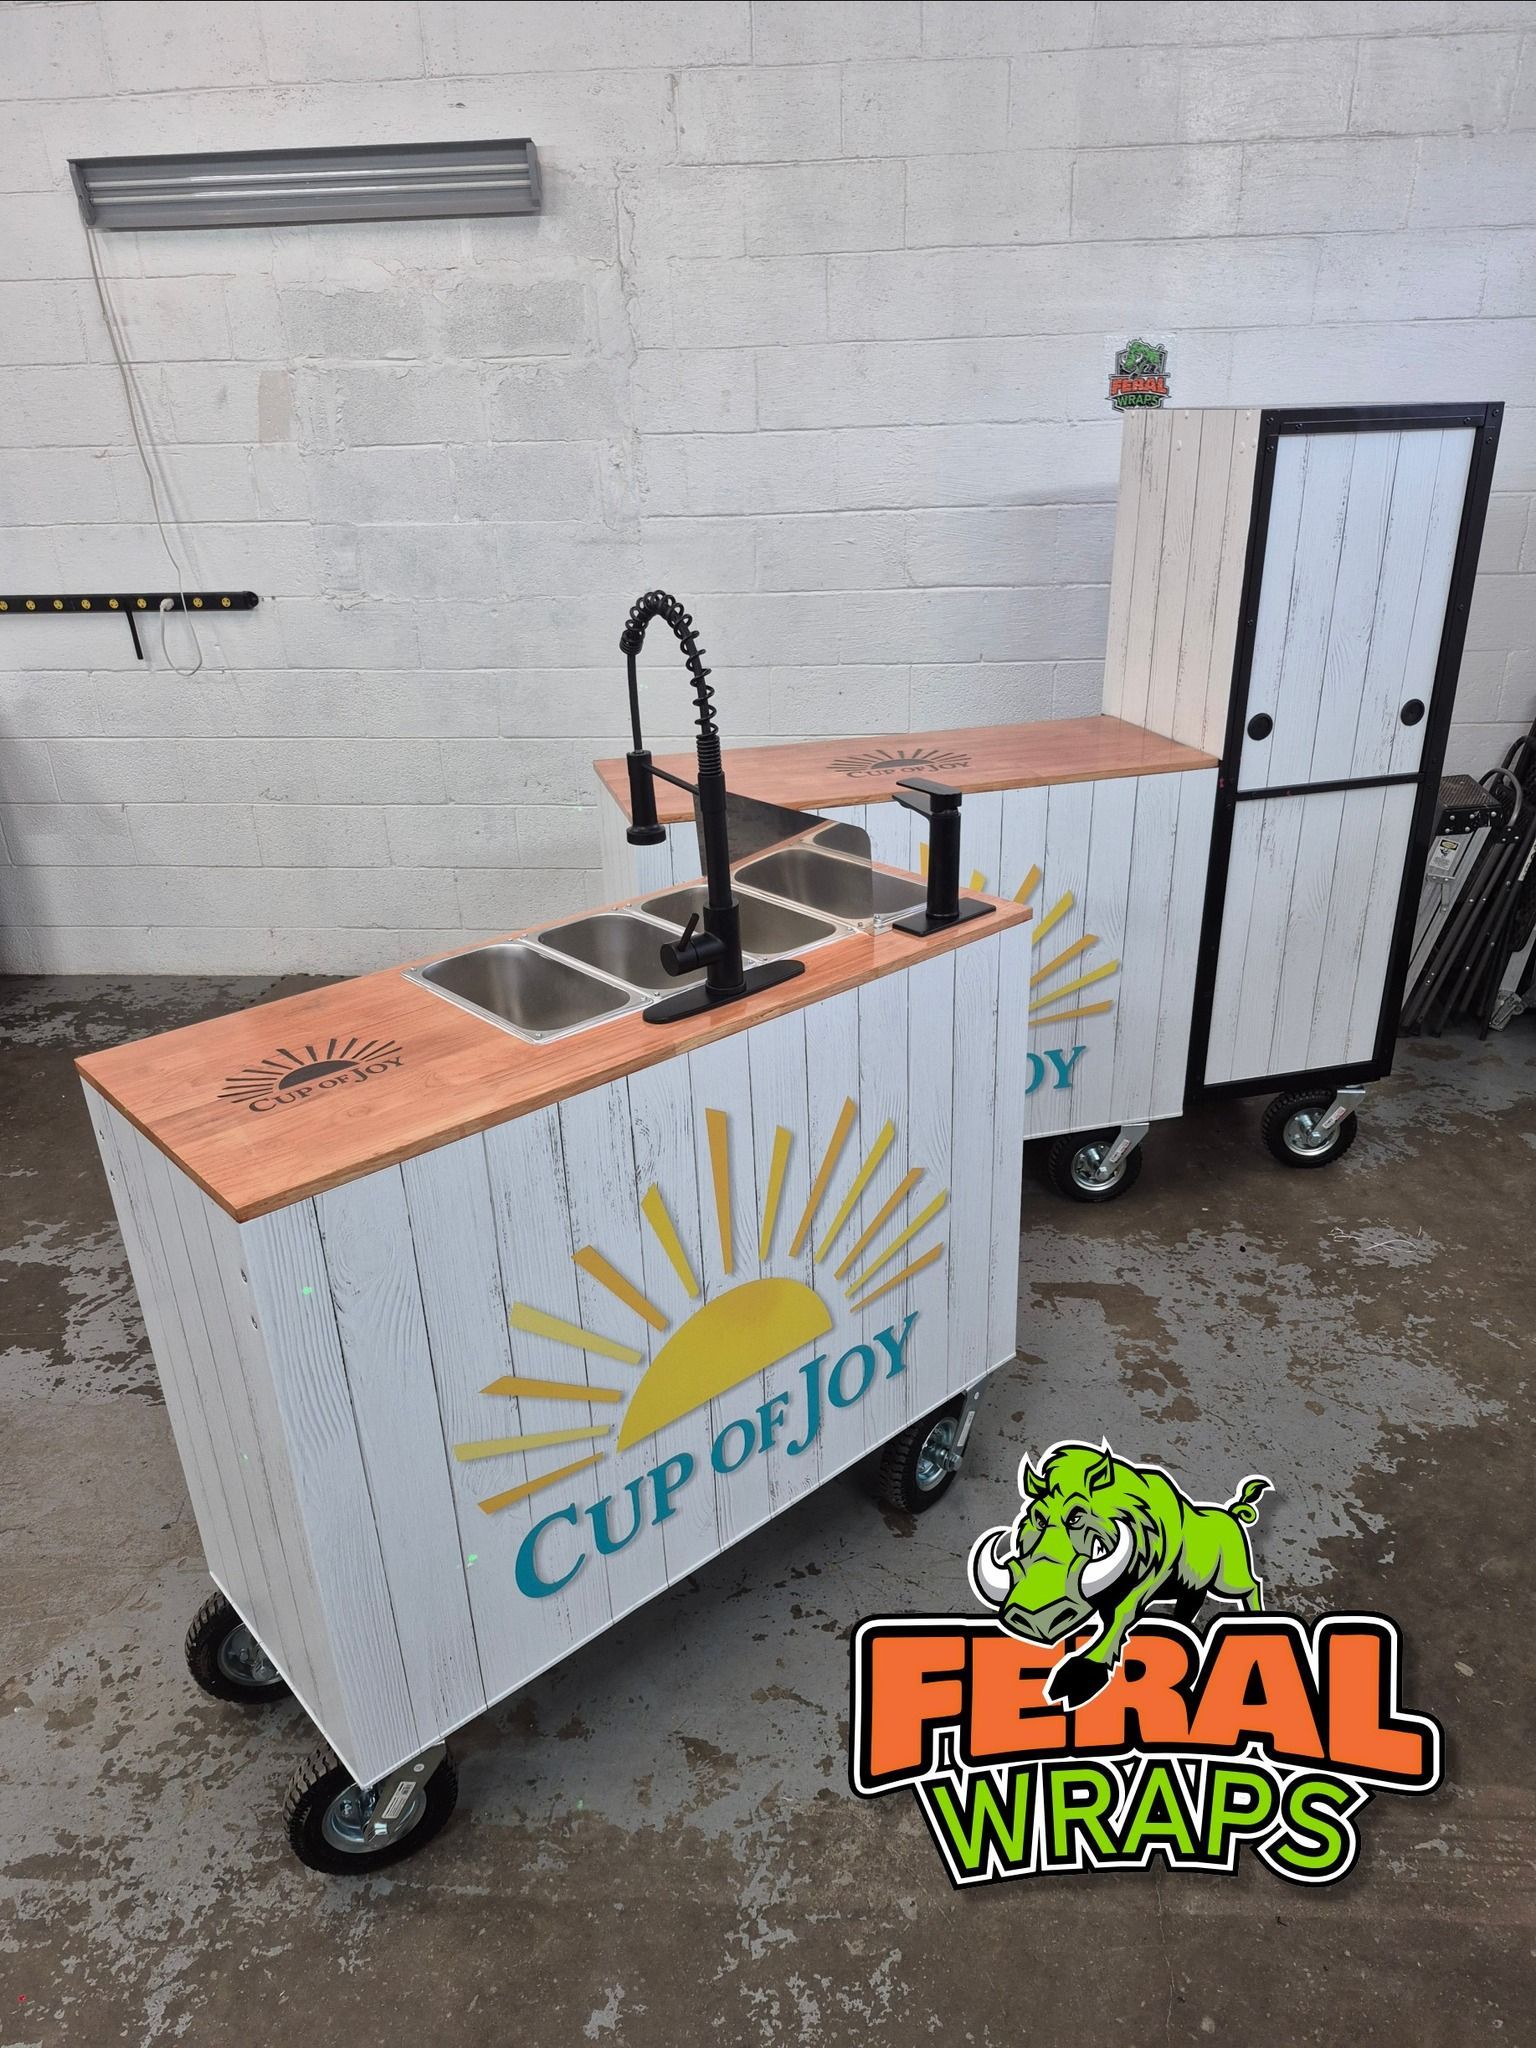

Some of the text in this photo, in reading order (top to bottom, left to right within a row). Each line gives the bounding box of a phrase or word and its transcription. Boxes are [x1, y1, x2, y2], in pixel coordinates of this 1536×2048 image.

[1110, 377, 1168, 396] FERAL
[1117, 394, 1160, 407] WRAPS
[846, 762, 970, 779] CUP OF JOY
[249, 1056, 405, 1112] CUP OF JOY
[514, 1311, 919, 1599] CUP OF JOY
